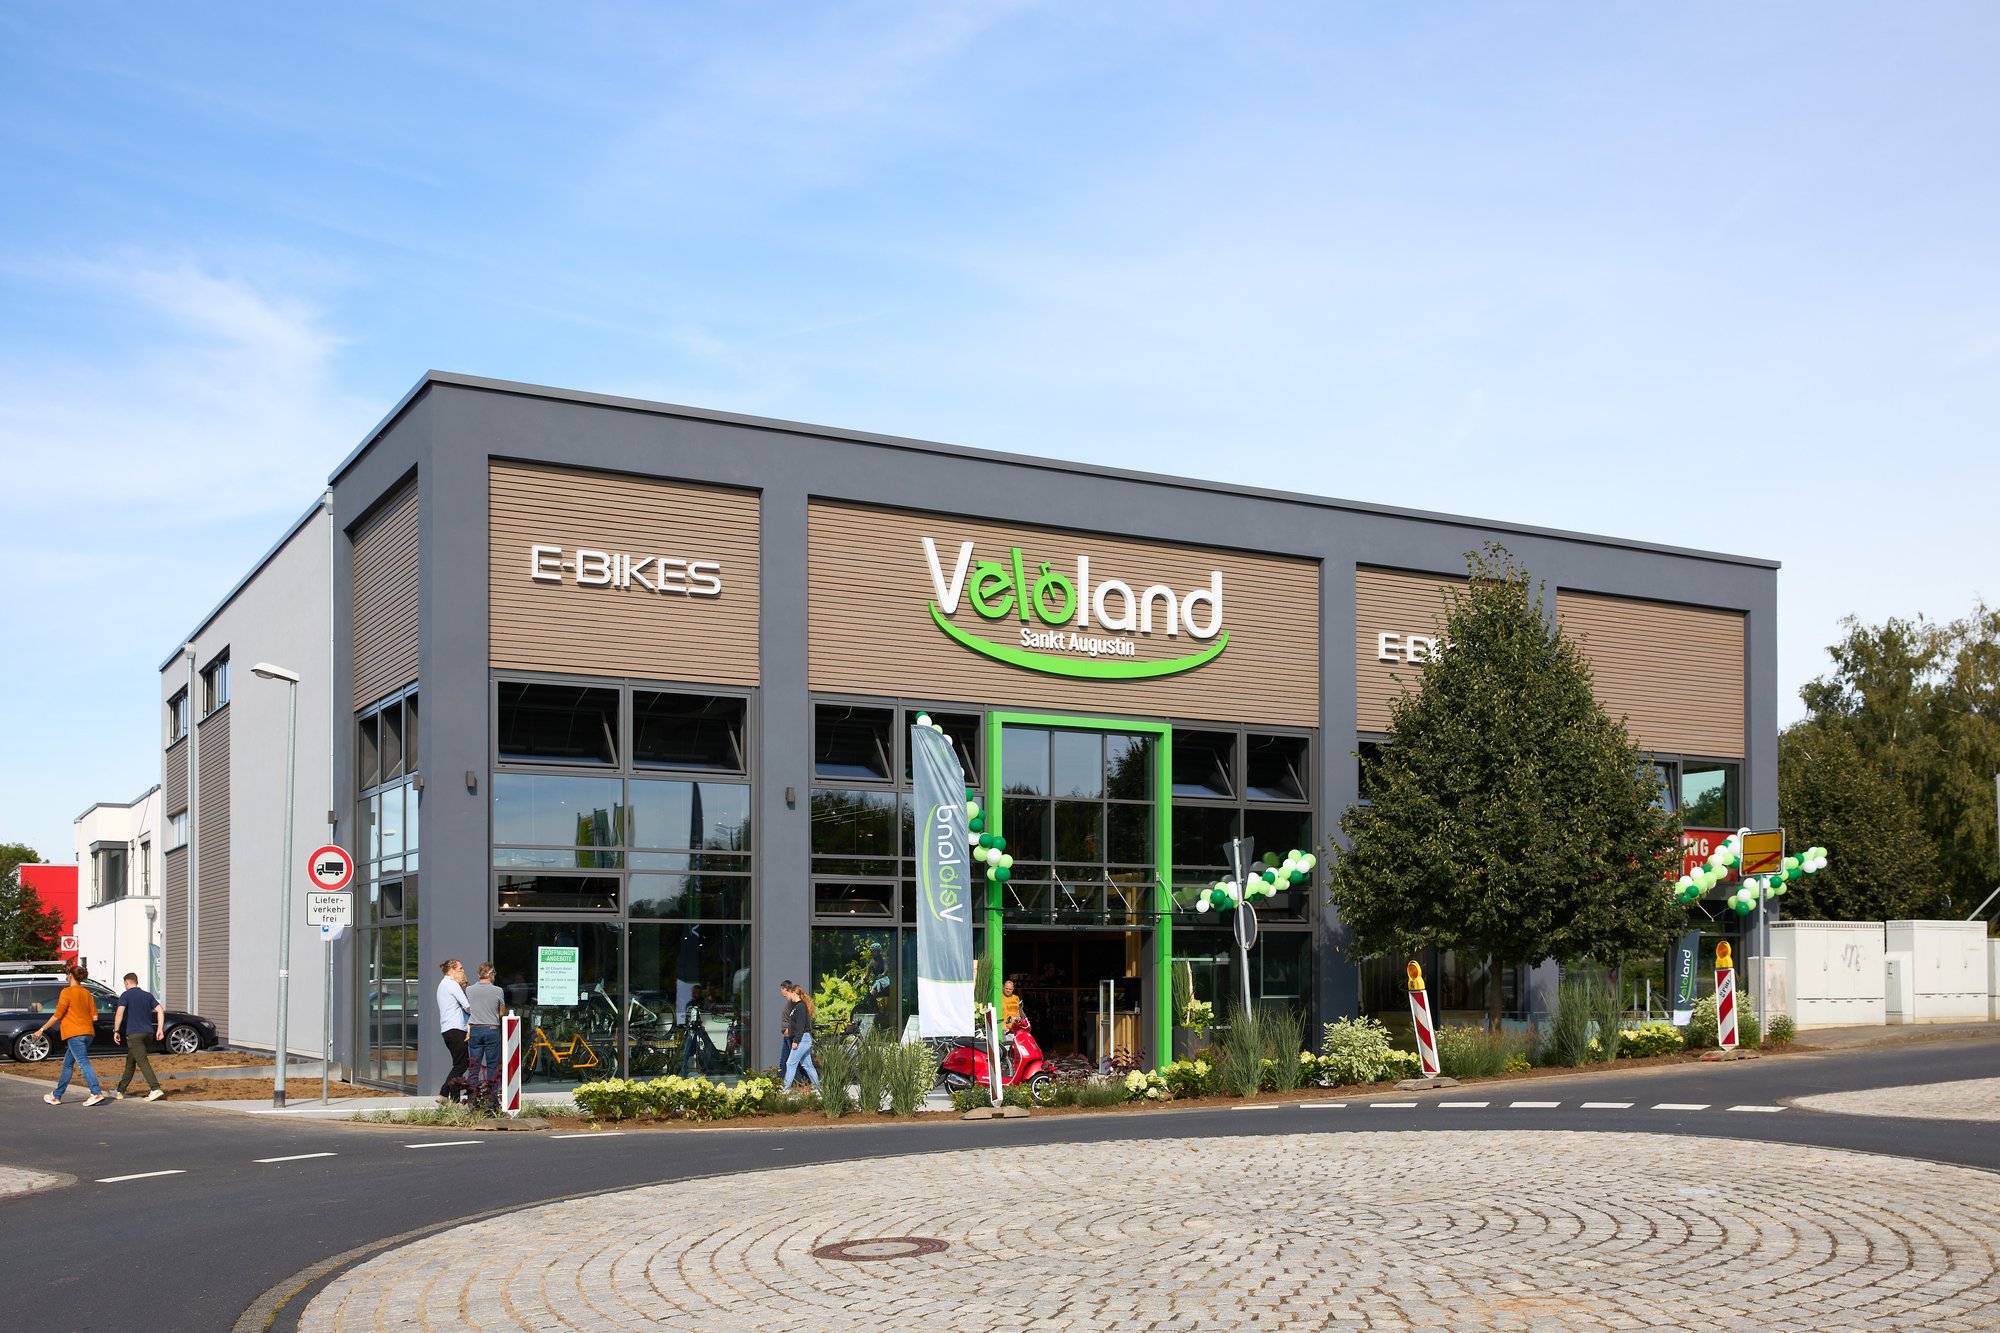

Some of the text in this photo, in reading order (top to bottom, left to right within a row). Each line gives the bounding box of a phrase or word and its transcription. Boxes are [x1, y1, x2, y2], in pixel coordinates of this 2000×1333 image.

[531, 544, 722, 595] E-BIKES
[921, 536, 1223, 639] Veloland
[1020, 628, 1135, 657] Sankt Augustin
[313, 905, 346, 913] verkehr
[315, 896, 344, 904] Liefer-
[322, 914, 337, 922] frei
